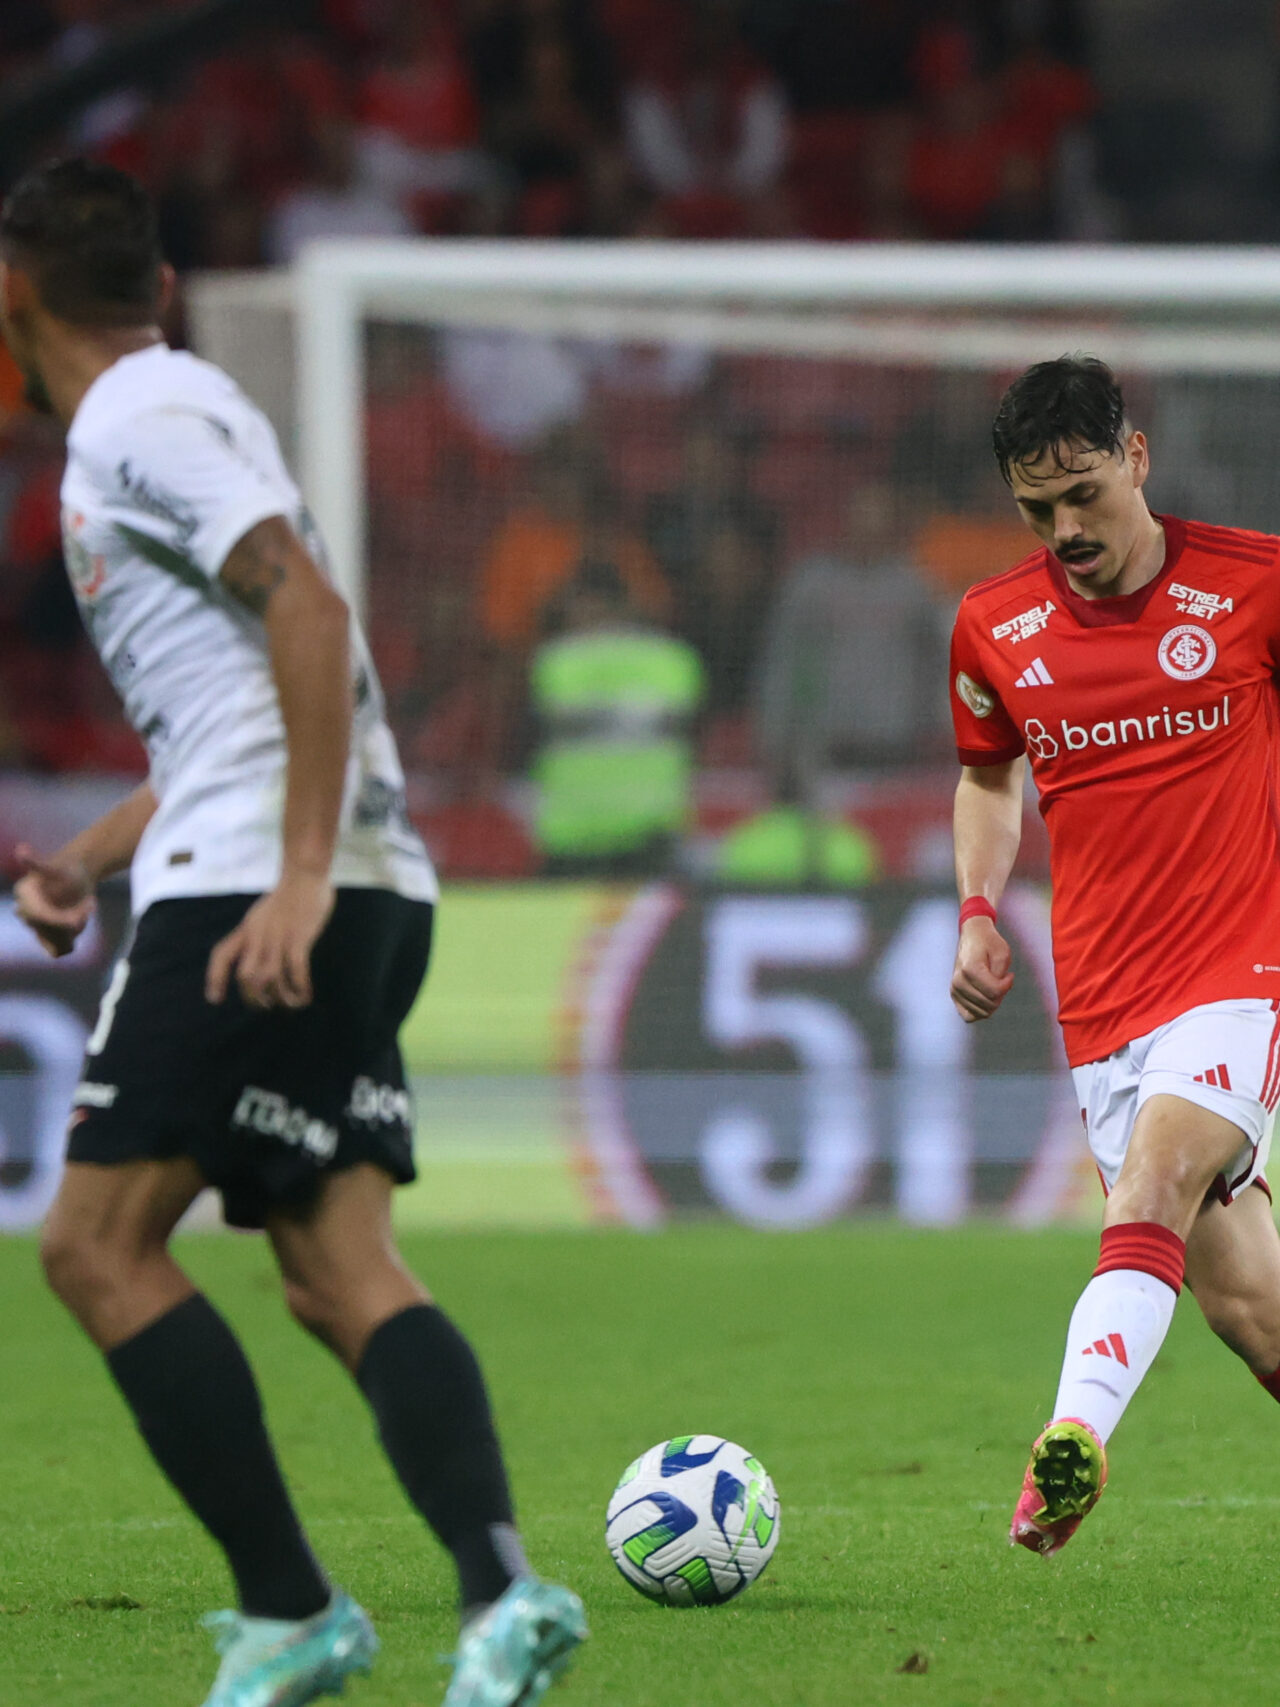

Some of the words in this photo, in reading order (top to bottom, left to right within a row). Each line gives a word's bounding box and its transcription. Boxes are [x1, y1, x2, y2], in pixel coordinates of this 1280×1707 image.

[1167, 582, 1234, 613] ESTRELA
[1186, 602, 1220, 621] BET
[991, 600, 1057, 640] ESTRELA
[1019, 615, 1048, 640] BET
[1061, 695, 1230, 751] banrisul
[700, 893, 969, 1229] 51
